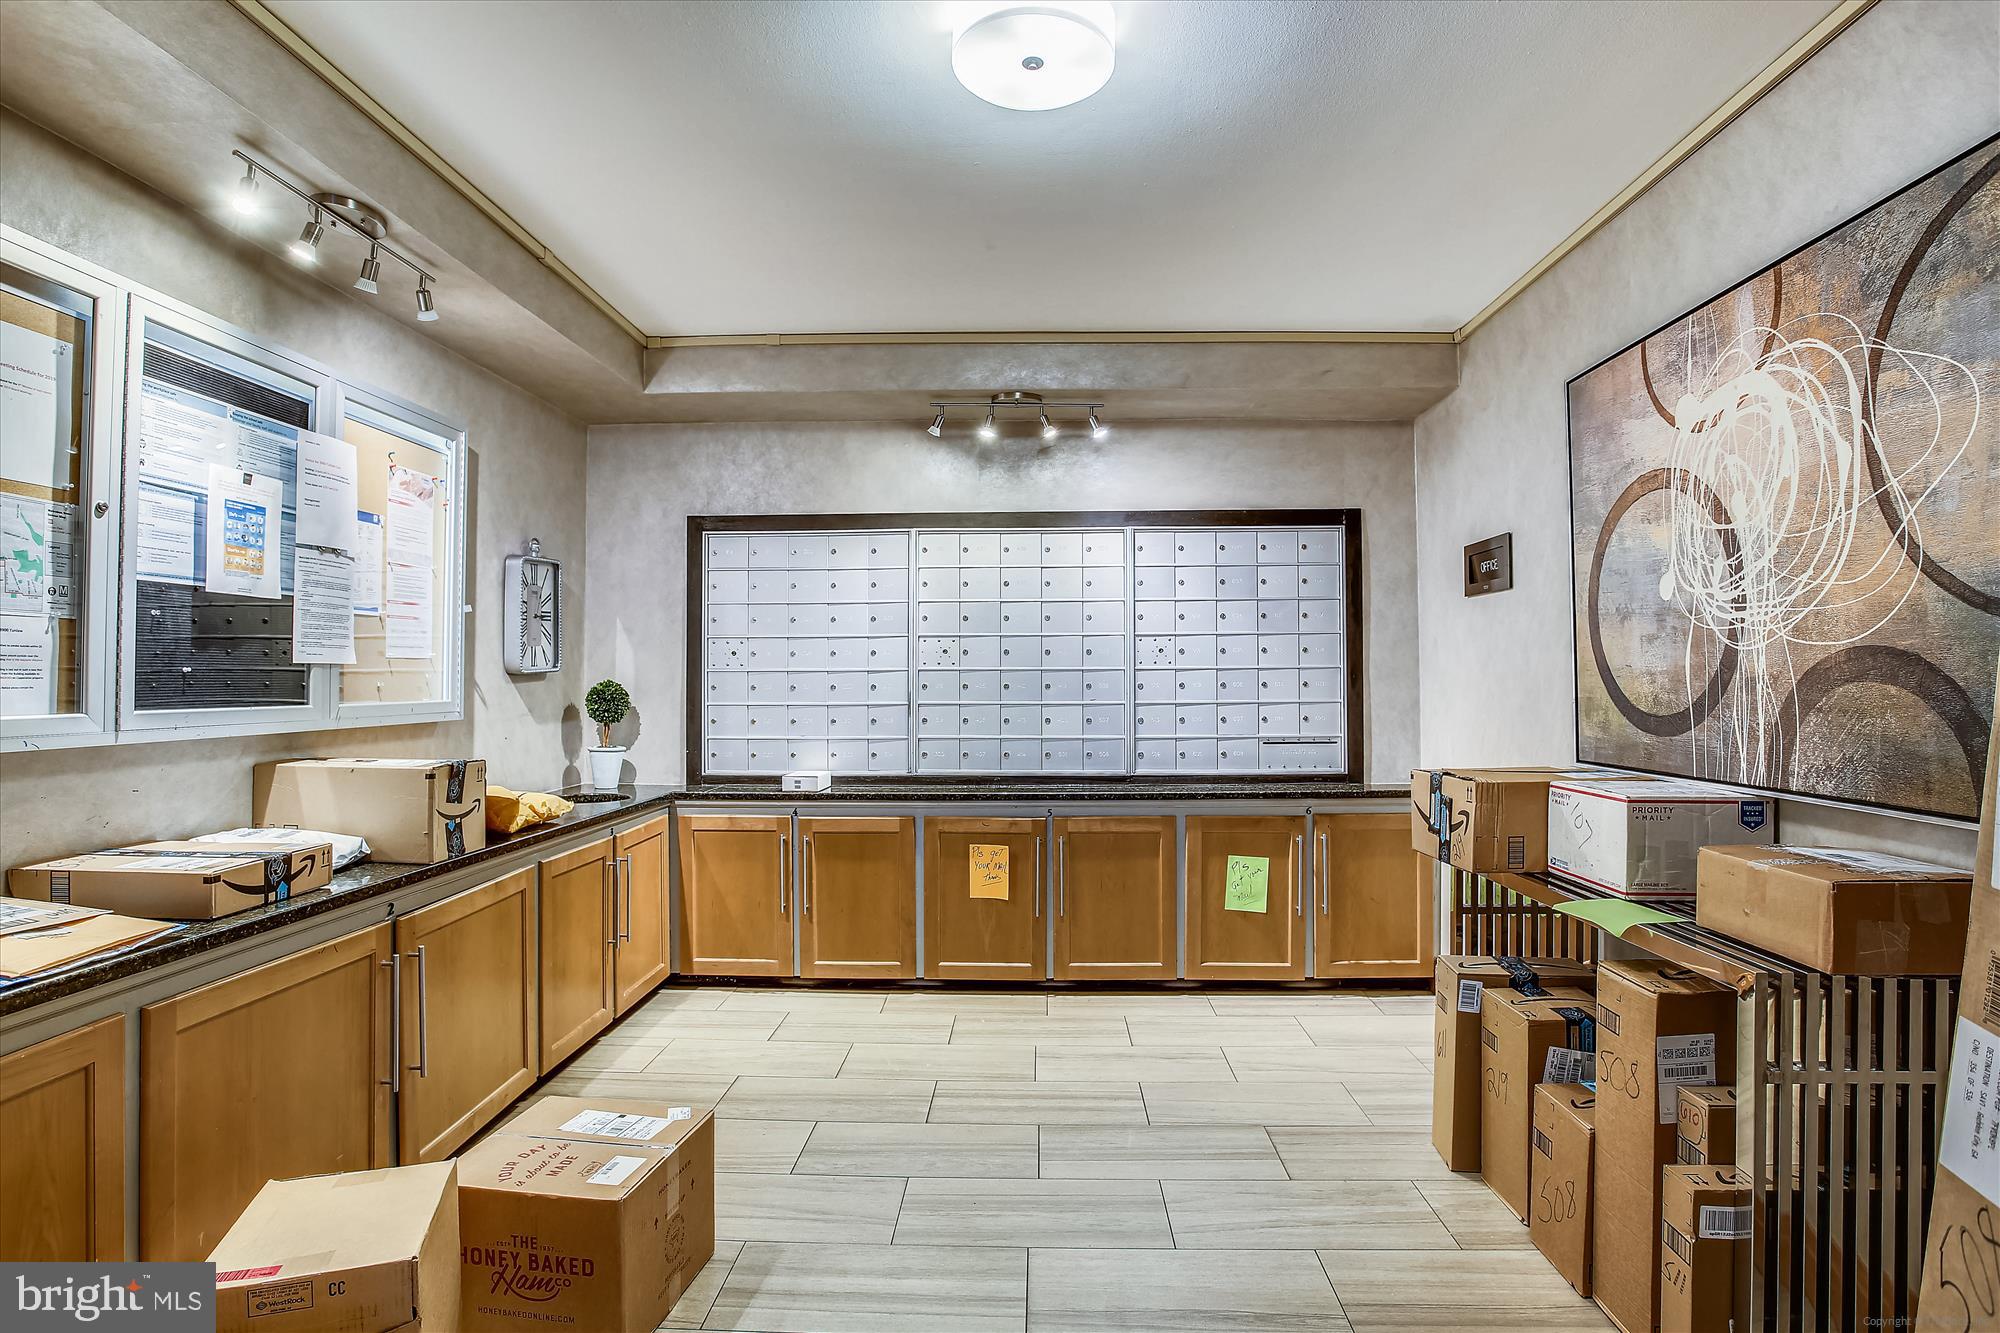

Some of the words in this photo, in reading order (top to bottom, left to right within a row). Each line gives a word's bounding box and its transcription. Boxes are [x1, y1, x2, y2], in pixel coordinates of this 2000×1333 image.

[16, 366, 36, 376] Schedule
[1480, 558, 1499, 573] OFFICE
[1551, 790, 1571, 801] PRIORITY
[791, 807, 799, 817] 4
[1047, 808, 1053, 817] 5
[1305, 806, 1312, 815] 6
[1632, 806, 1674, 814] PRIORITY
[387, 902, 395, 916] 2
[1600, 1050, 1640, 1099] 508
[1981, 1046, 1995, 1087] DESTINATION
[498, 1161, 519, 1182] YOUR
[517, 1144, 546, 1158] DAY
[526, 1160, 550, 1180] about
[545, 1155, 579, 1177] MADE
[1537, 1175, 1577, 1223] 508
[510, 1234, 538, 1250] THE
[460, 1246, 520, 1269] HONEY
[528, 1253, 595, 1277] BAKED
[327, 1280, 347, 1297] CC
[491, 1263, 560, 1301] Ham
[555, 1277, 572, 1288] CO
[268, 1296, 305, 1308] WestRock
[478, 1306, 576, 1324] HONEYBAKEDONLINE.COM
